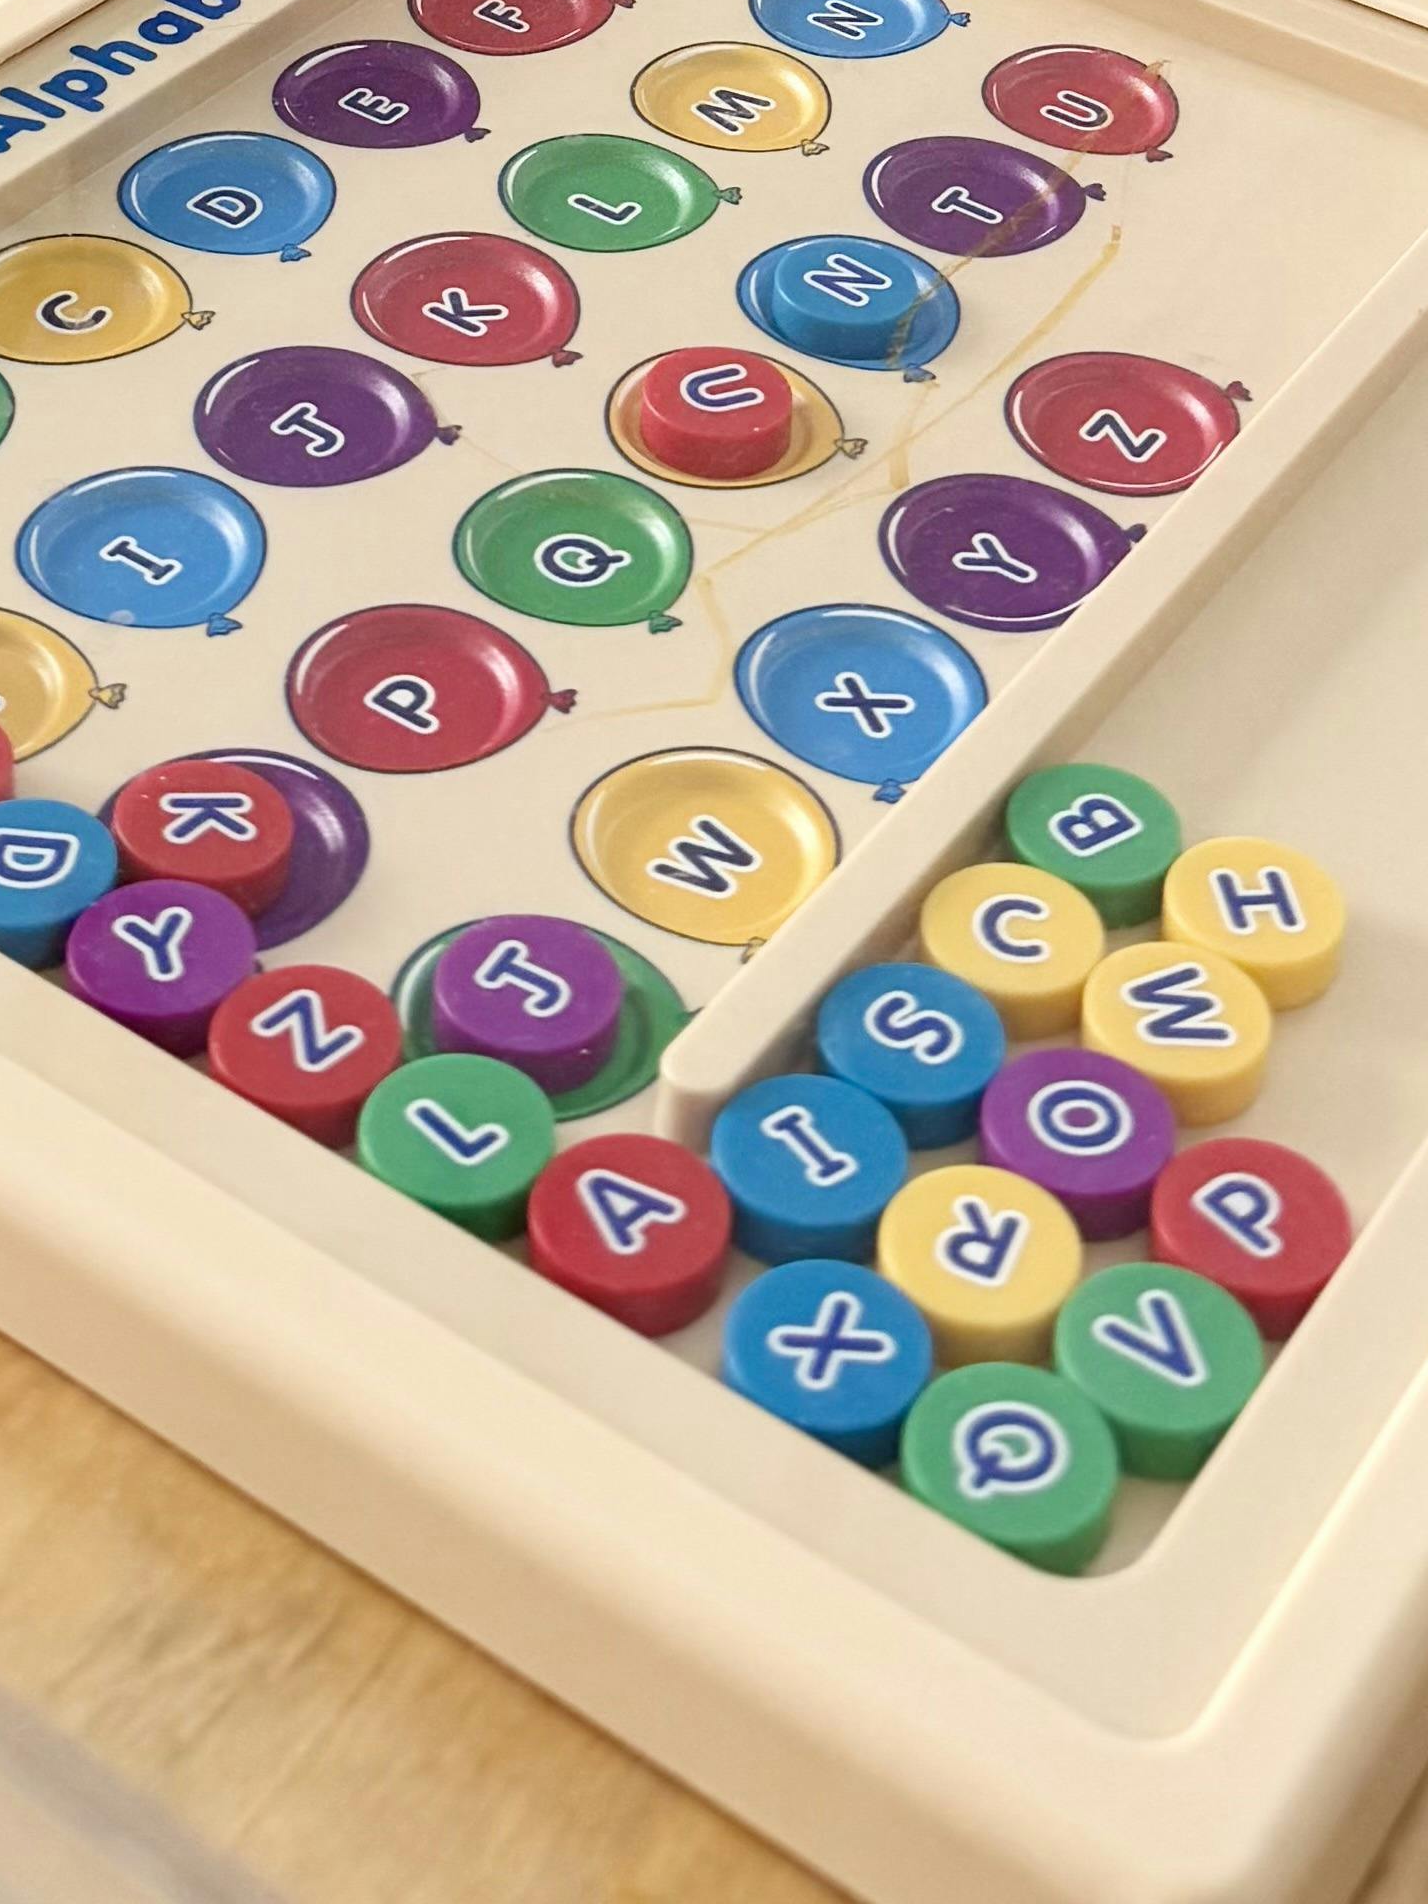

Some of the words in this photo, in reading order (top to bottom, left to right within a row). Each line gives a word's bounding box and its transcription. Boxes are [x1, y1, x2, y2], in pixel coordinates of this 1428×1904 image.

[338, 86, 409, 125] E
[691, 86, 776, 135] M
[1039, 89, 1115, 133] U
[186, 184, 264, 229] D
[567, 191, 643, 227] L
[932, 184, 1004, 226] T
[36, 290, 114, 335] C
[421, 286, 509, 338] K
[803, 252, 892, 307] N
[680, 362, 765, 413] U
[268, 401, 347, 459] J
[1078, 407, 1168, 467] Z
[98, 534, 184, 586] I
[532, 533, 631, 588] Q
[950, 531, 1039, 587] Y
[363, 673, 442, 737] P
[814, 670, 916, 741] X
[159, 789, 256, 846] K
[1047, 791, 1145, 858] B
[647, 813, 764, 901] W
[970, 891, 1053, 963] C
[1209, 864, 1308, 936] H
[111, 905, 193, 983] Y
[474, 937, 572, 1021] J
[249, 986, 365, 1073] Z
[863, 989, 964, 1066] S
[403, 1095, 509, 1166] L
[759, 1104, 860, 1190] I
[1026, 1078, 1136, 1157] O
[573, 1168, 687, 1256] A
[934, 1194, 1032, 1289] R
[1191, 1170, 1286, 1261] P
[766, 1289, 898, 1393] X
[1092, 1287, 1210, 1389] V
[951, 1398, 1075, 1500] Q
